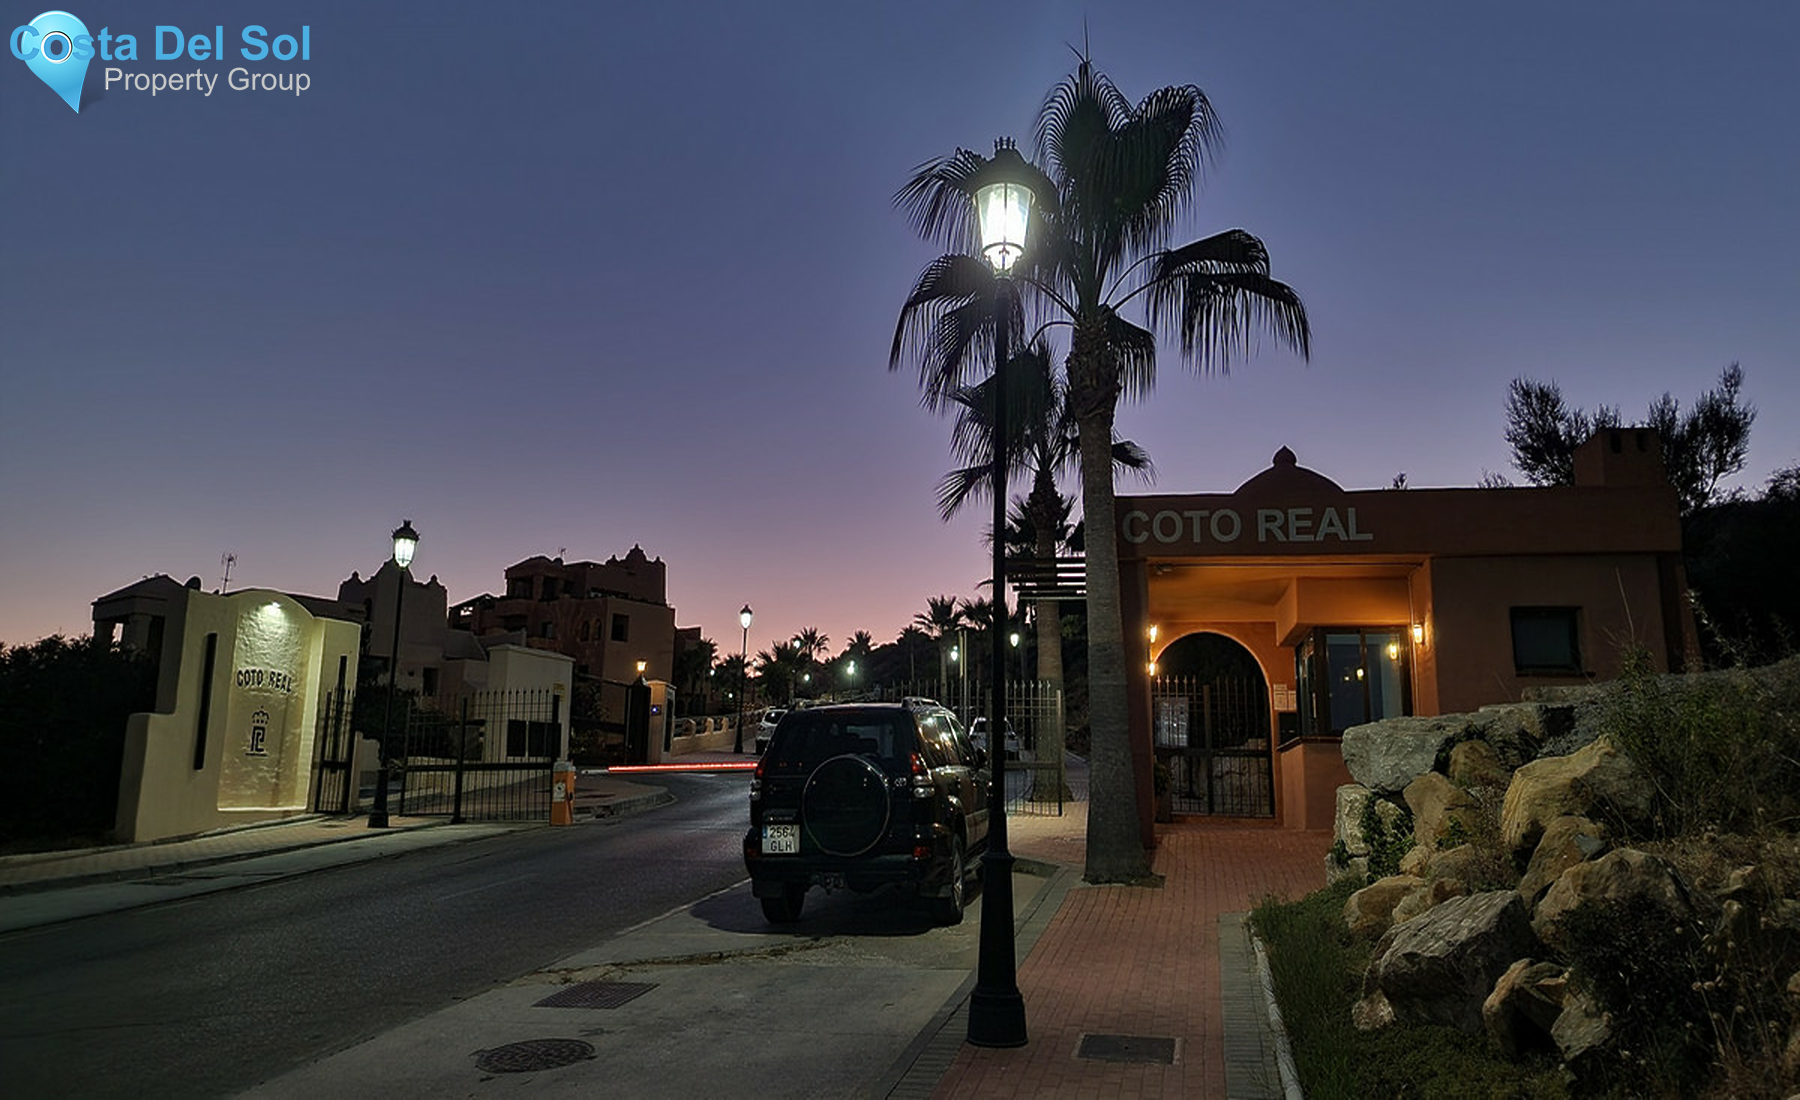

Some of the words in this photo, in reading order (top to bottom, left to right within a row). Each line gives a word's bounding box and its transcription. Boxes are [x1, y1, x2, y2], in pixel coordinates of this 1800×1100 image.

[1122, 509, 1241, 543] COTO
[1257, 507, 1373, 542] REAL
[237, 669, 263, 686] COTO
[269, 671, 291, 692] REAL
